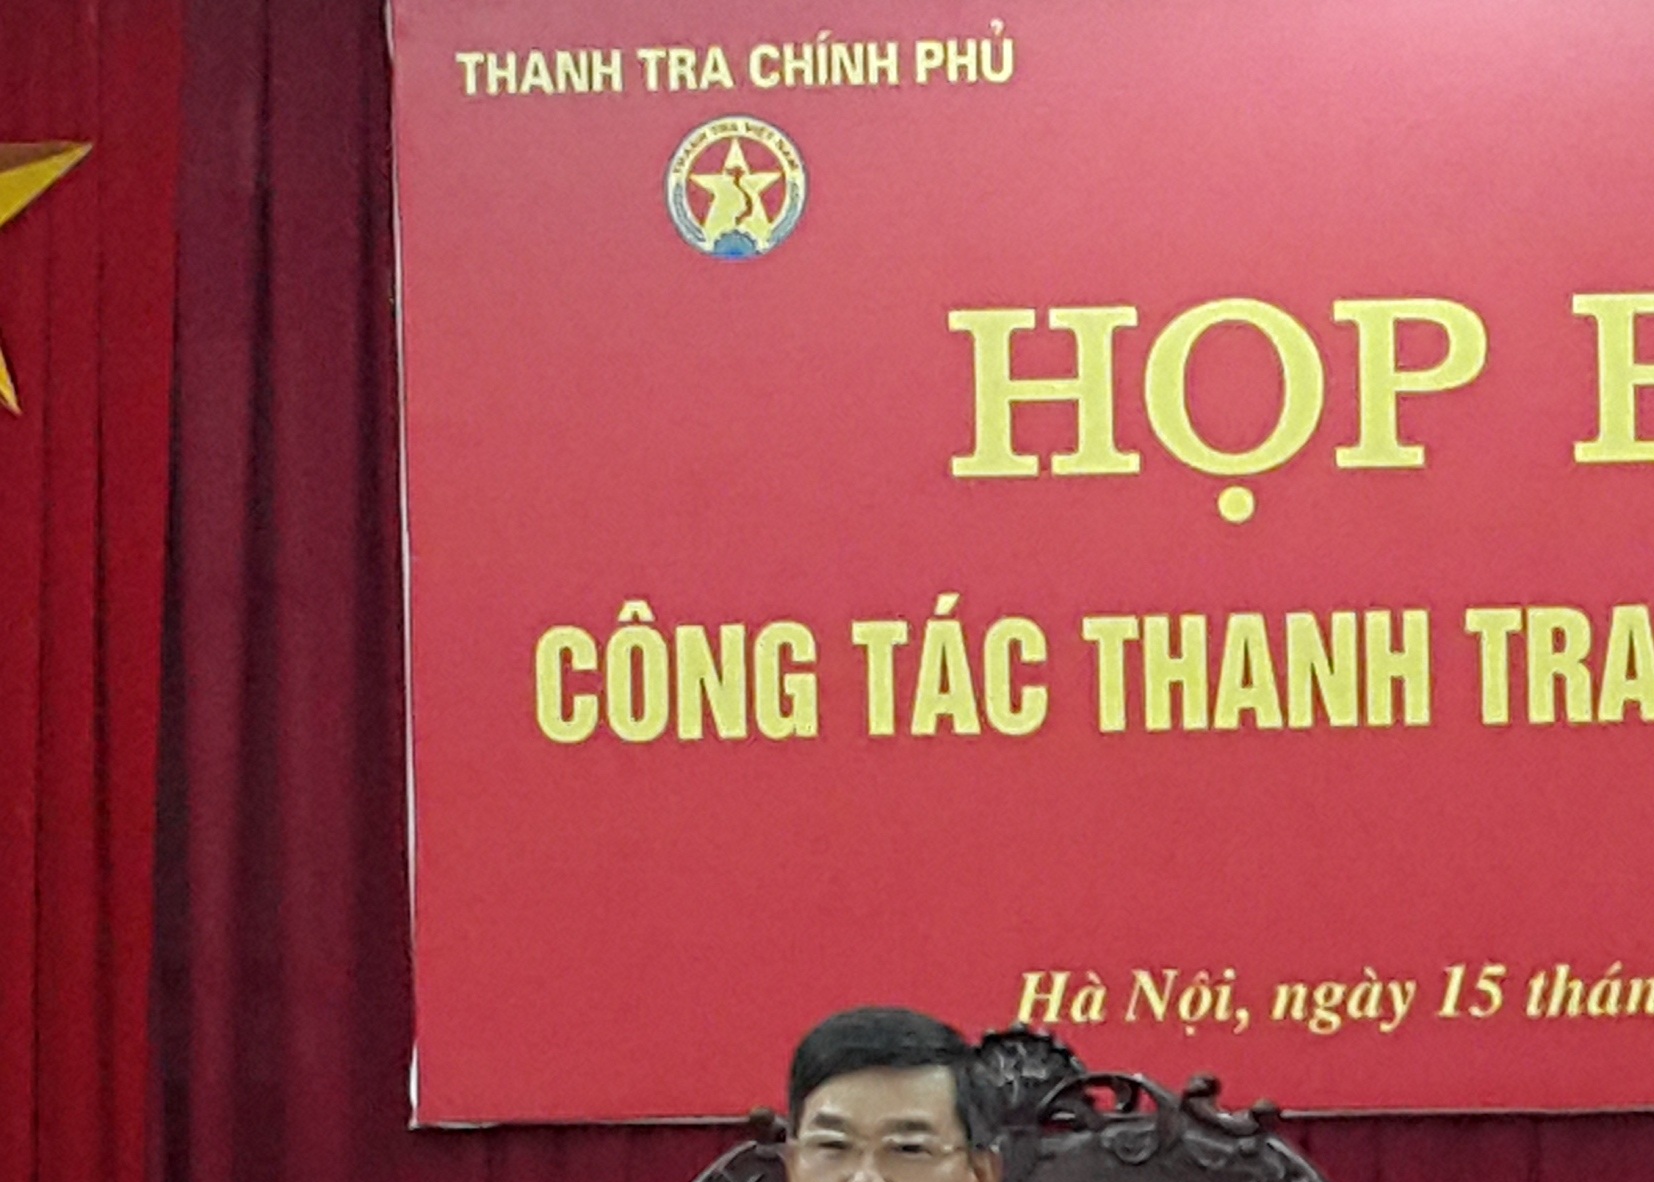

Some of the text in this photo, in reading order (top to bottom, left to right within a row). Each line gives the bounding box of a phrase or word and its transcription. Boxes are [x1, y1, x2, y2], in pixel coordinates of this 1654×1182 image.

[455, 18, 1015, 97] THANH TRA CHÍNH PHỦ
[947, 297, 1488, 524] HỌP
[535, 600, 819, 743] CÔNG
[850, 593, 1049, 737] TÁC
[1081, 608, 1432, 733] THANH
[1016, 969, 1106, 1024] Hà
[1125, 968, 1250, 1036] Nội,
[1271, 966, 1417, 1034] ngày
[1437, 963, 1507, 1018] 15
